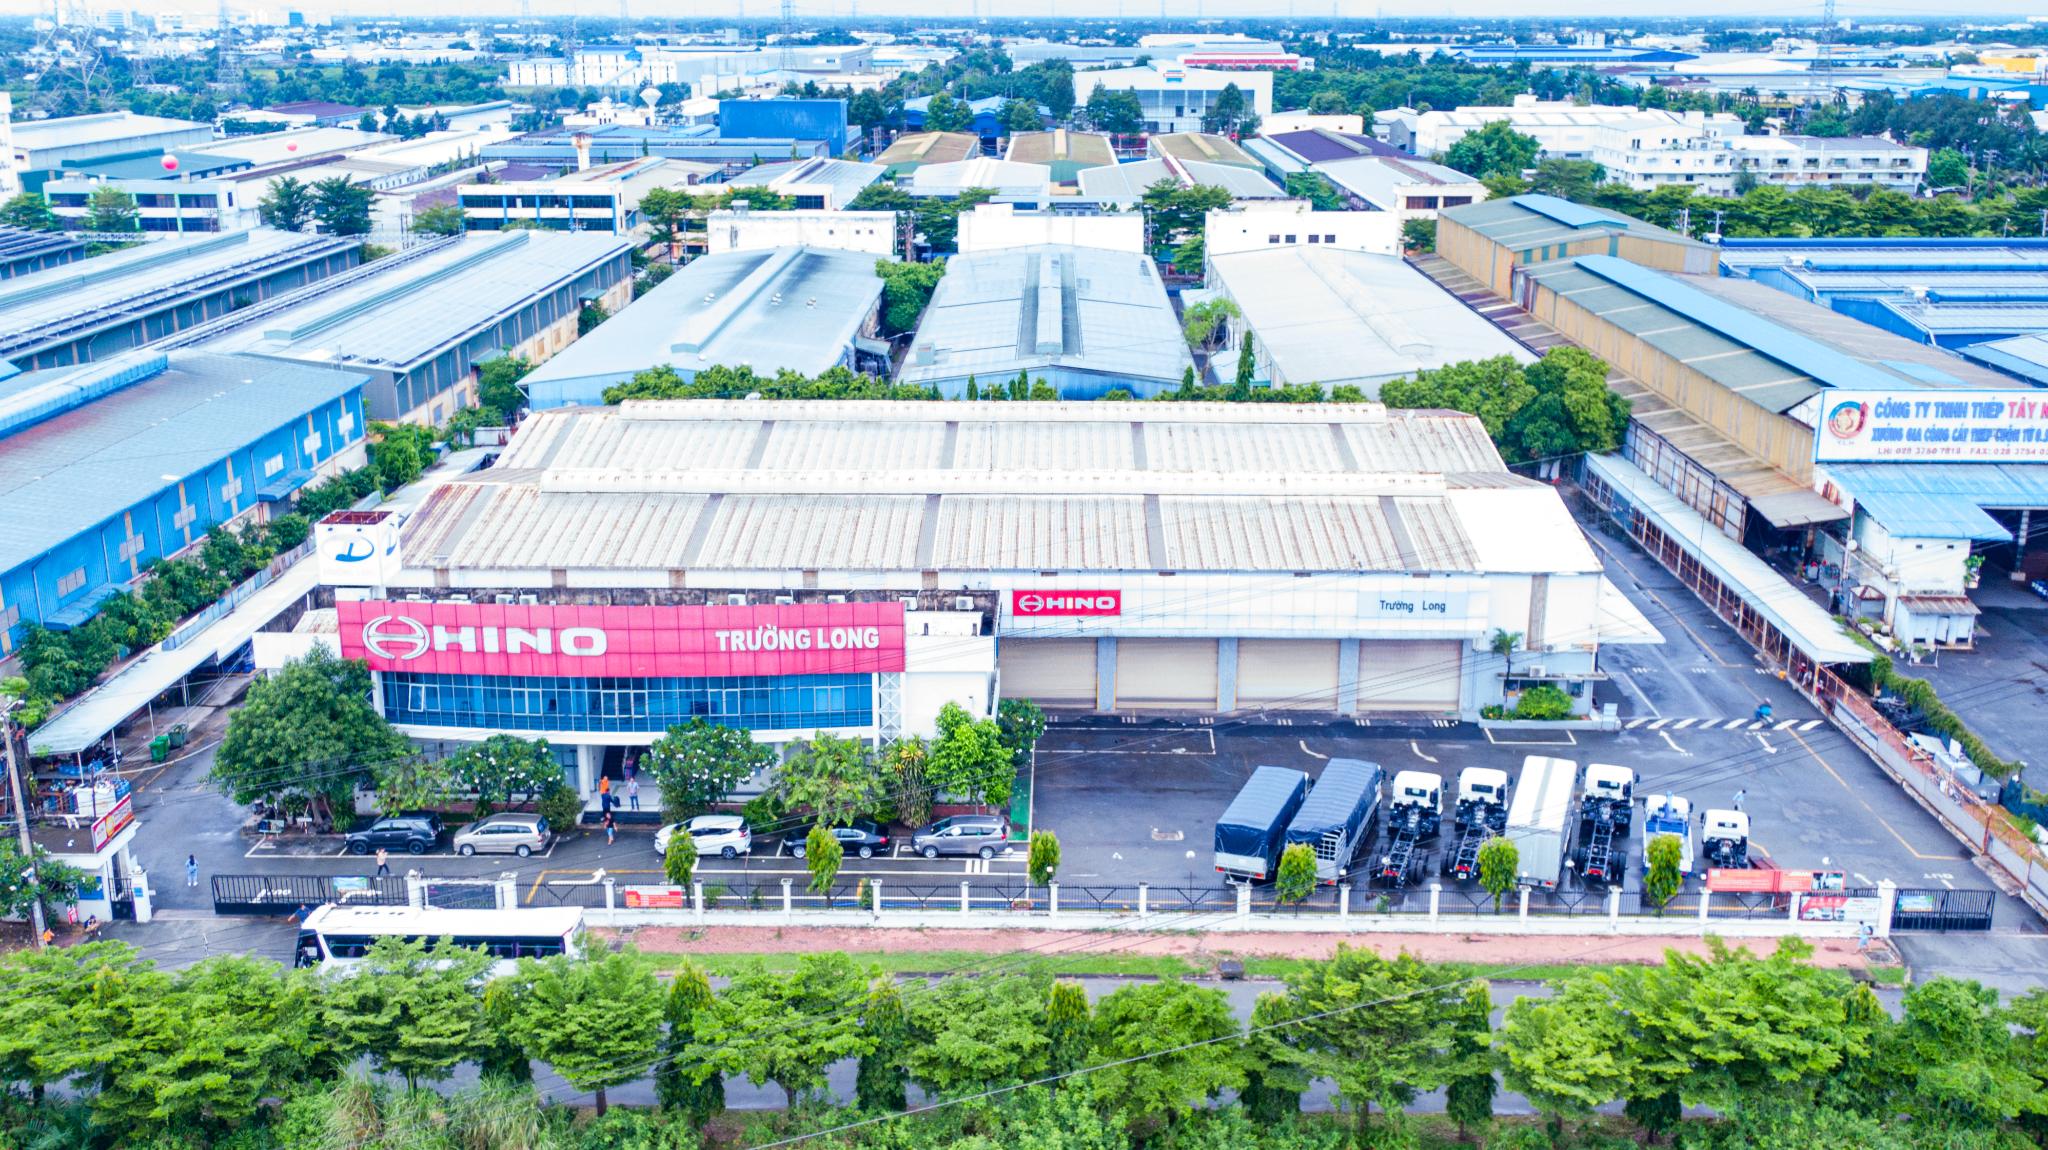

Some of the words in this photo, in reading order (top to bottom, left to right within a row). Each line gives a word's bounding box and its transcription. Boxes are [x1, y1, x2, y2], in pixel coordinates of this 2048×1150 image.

[1915, 402, 1931, 419] TY
[2008, 397, 2037, 419] TÂY
[1046, 596, 1116, 609] HINO
[1380, 600, 1414, 613] Trường
[1422, 601, 1446, 613] Long
[433, 625, 608, 656] HINO
[715, 624, 811, 651] TRƯỜNG
[817, 627, 879, 649] LONG
